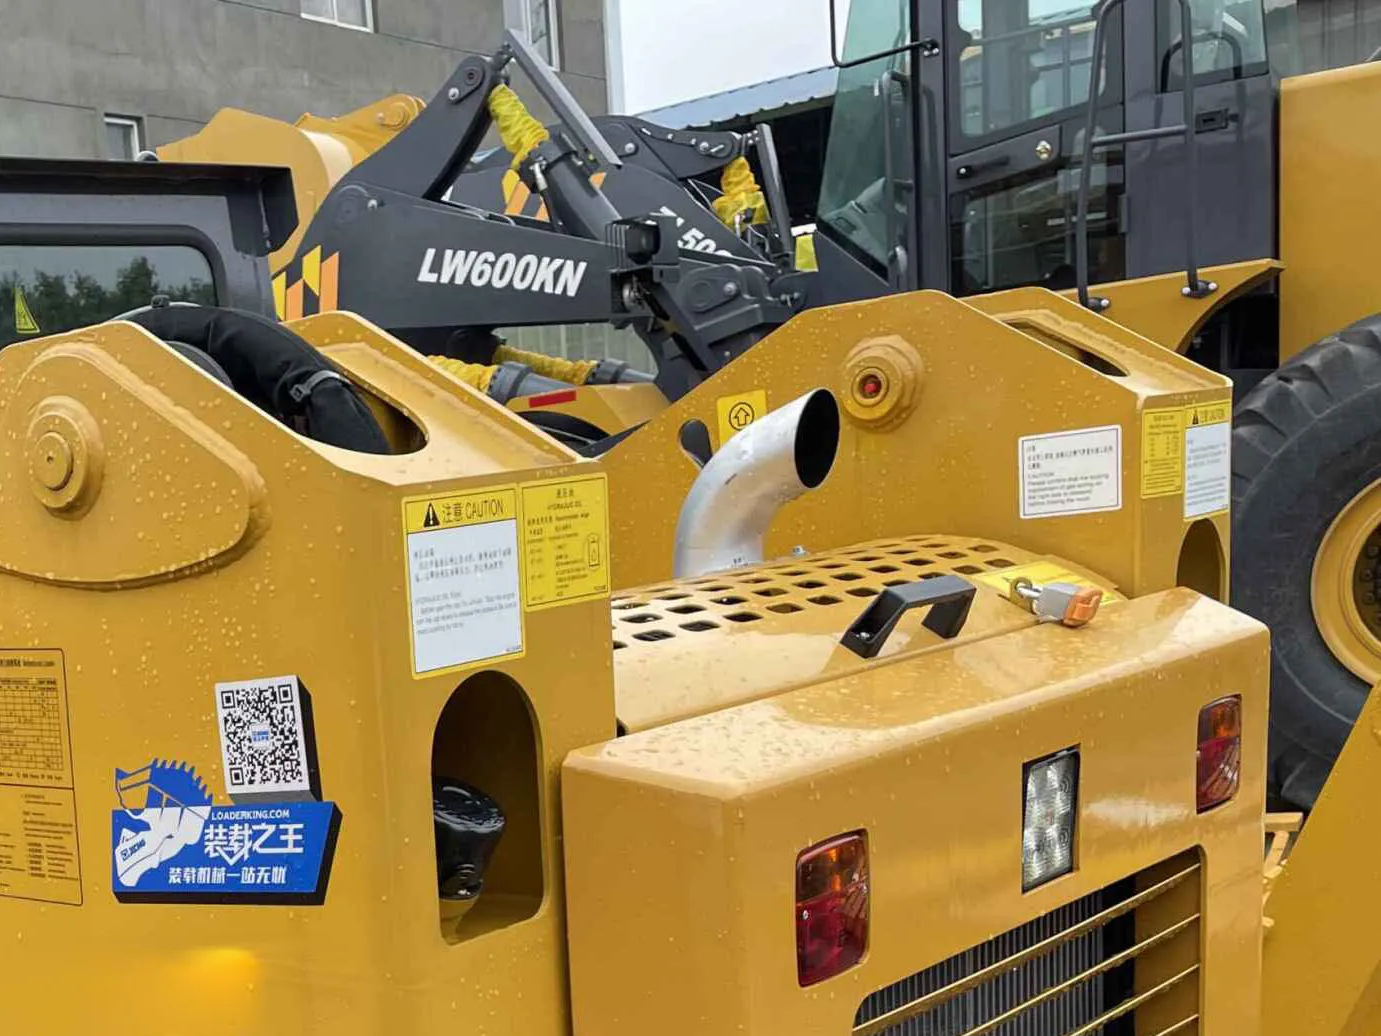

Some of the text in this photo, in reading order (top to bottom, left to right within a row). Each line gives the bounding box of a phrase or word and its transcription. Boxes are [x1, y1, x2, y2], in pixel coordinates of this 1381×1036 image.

[417, 247, 588, 298] LW600KN
[465, 498, 504, 520] CAUTION
[211, 809, 291, 821] LOADERKING.COM
[203, 822, 304, 866] 装载之王
